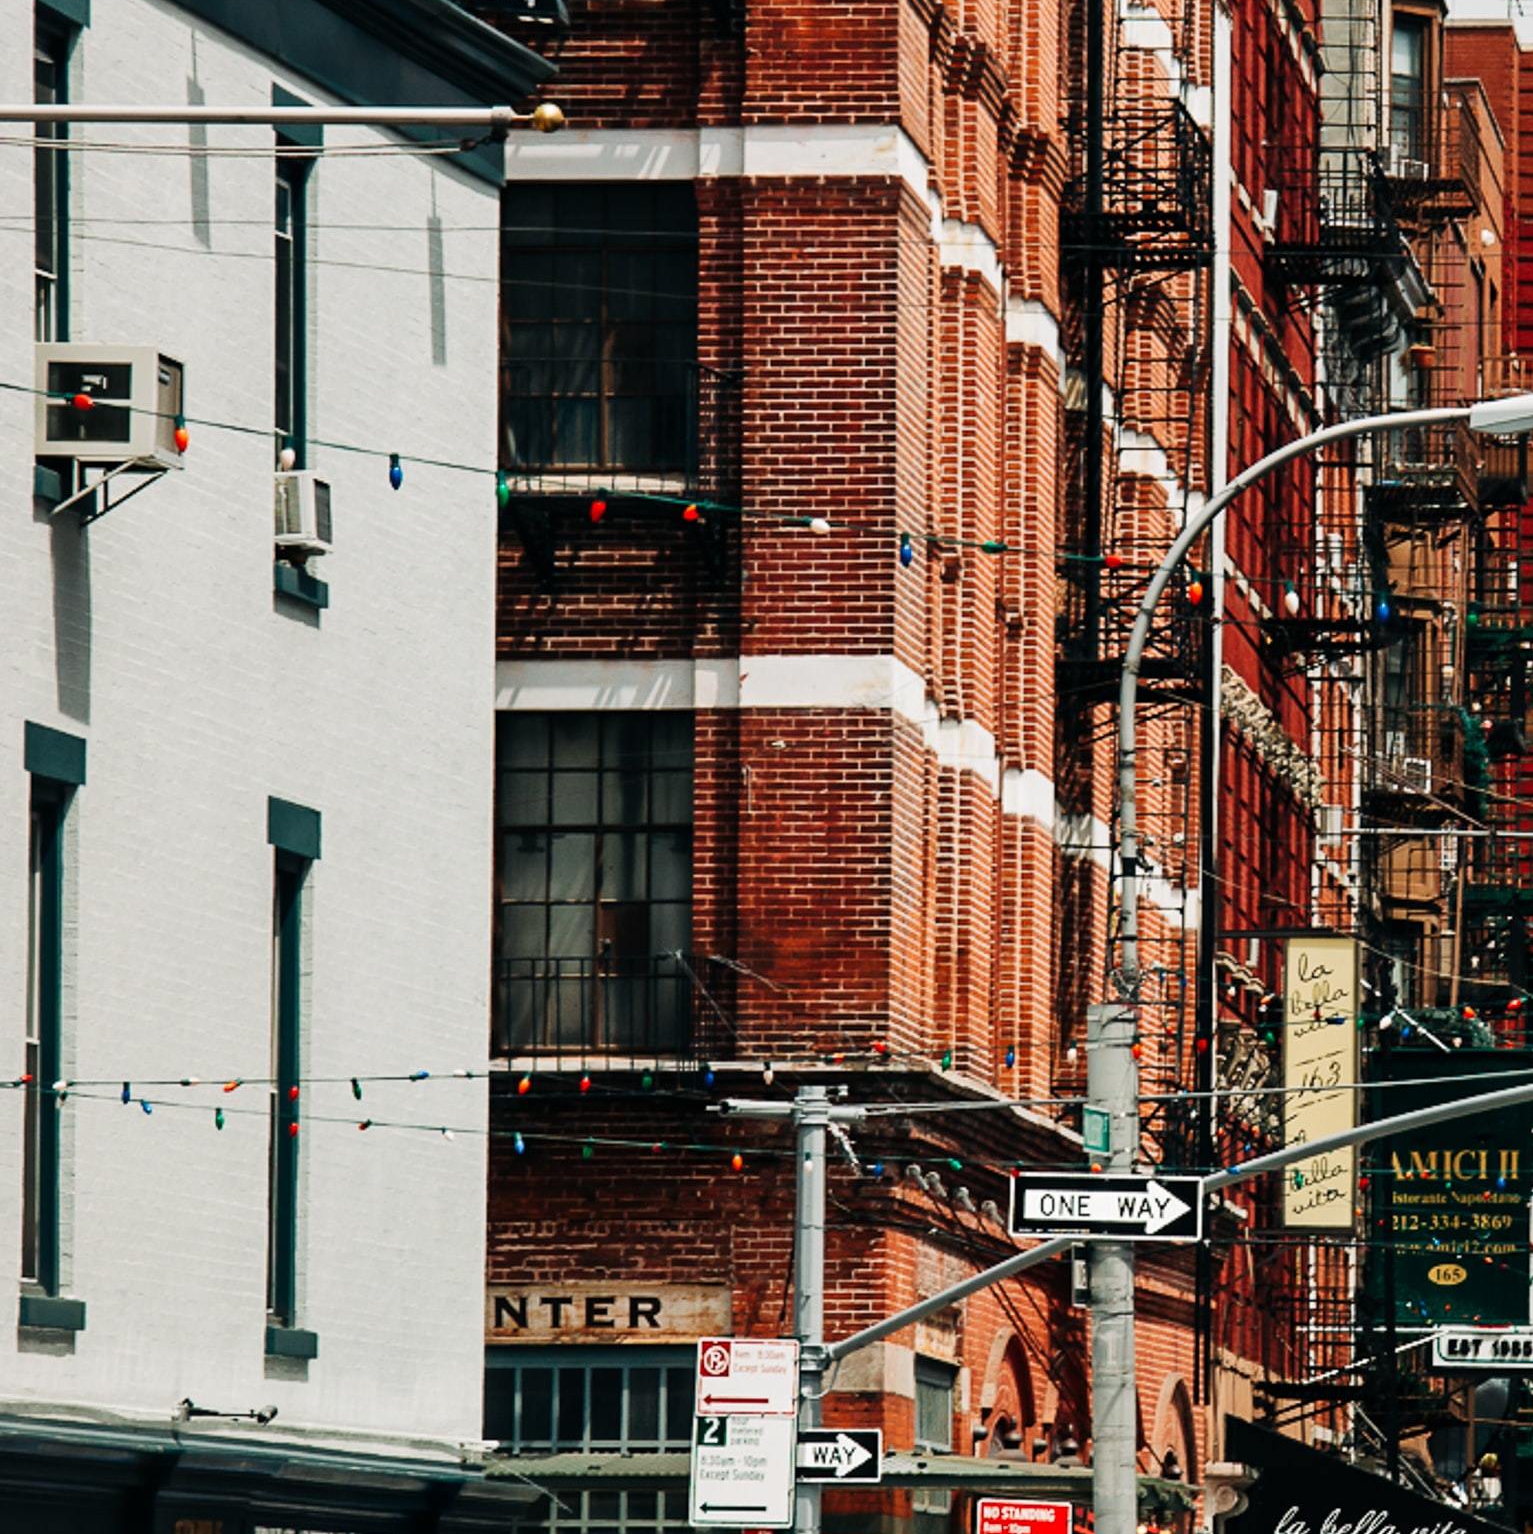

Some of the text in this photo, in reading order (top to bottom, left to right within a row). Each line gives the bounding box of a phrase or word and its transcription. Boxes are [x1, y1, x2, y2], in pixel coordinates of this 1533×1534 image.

[1041, 1194, 1170, 1218] ONE WAY
[1392, 1192, 1447, 1204] istorante
[1436, 1268, 1461, 1281] 165
[494, 1297, 661, 1328] NTER
[704, 1418, 719, 1443] 2
[813, 1446, 856, 1465] WAY
[700, 1469, 765, 1482] Except Sunday
[983, 1506, 1055, 1522] NO STANDING
